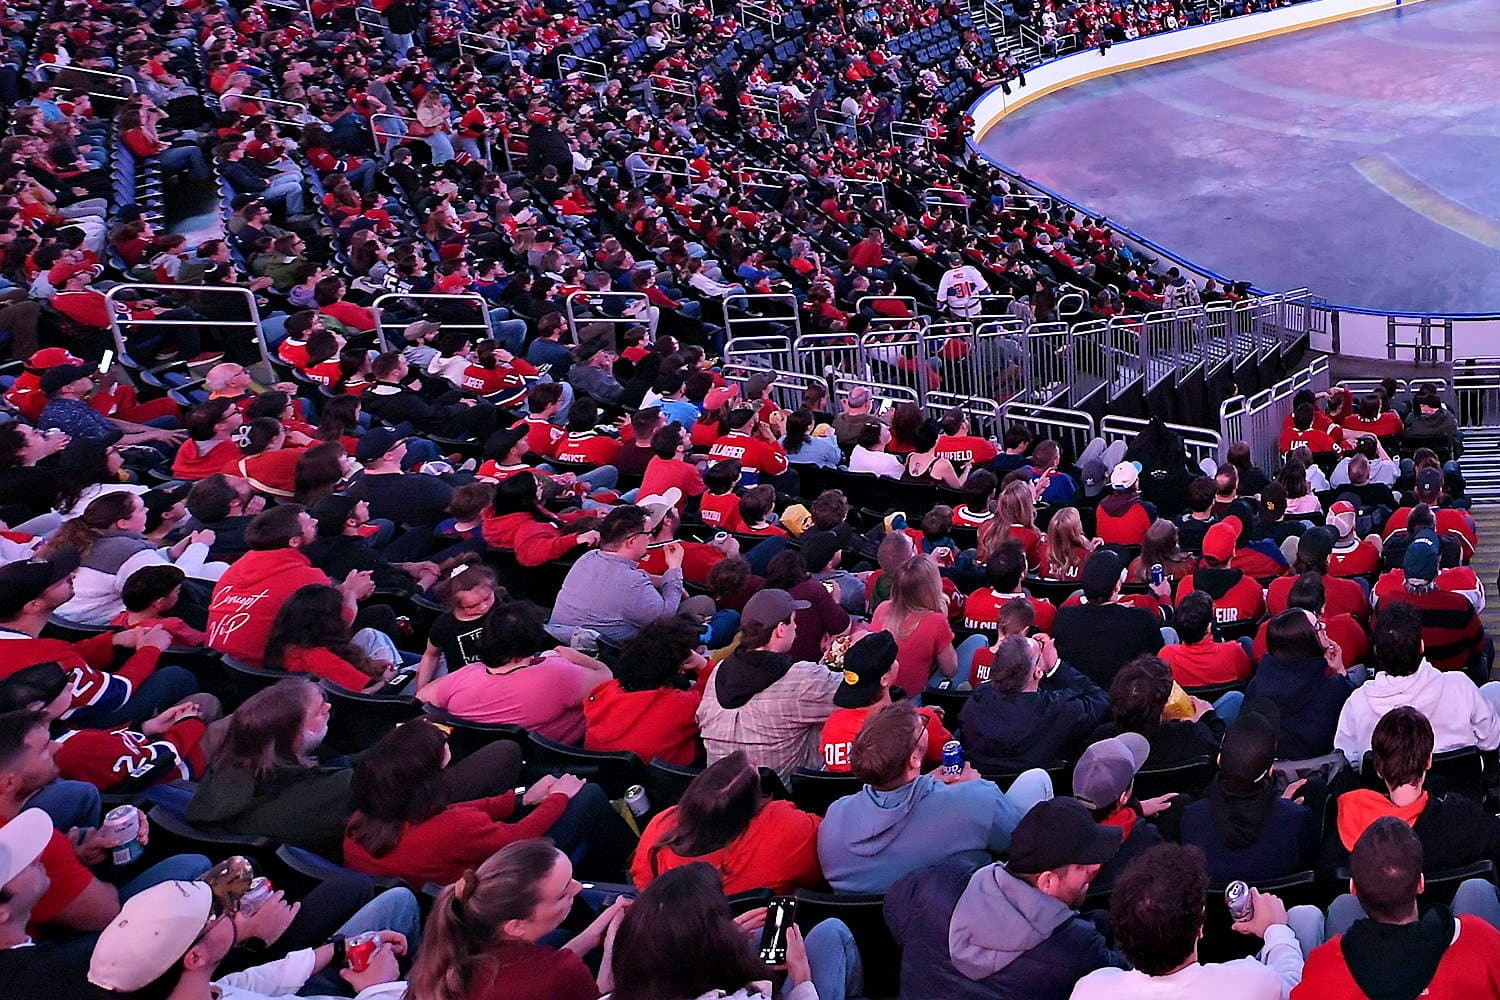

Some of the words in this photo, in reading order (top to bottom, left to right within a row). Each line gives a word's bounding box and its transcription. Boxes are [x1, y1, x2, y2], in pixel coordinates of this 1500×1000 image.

[954, 282, 971, 298] 31
[709, 444, 745, 459] ALLAGHER
[976, 664, 991, 679] HU
